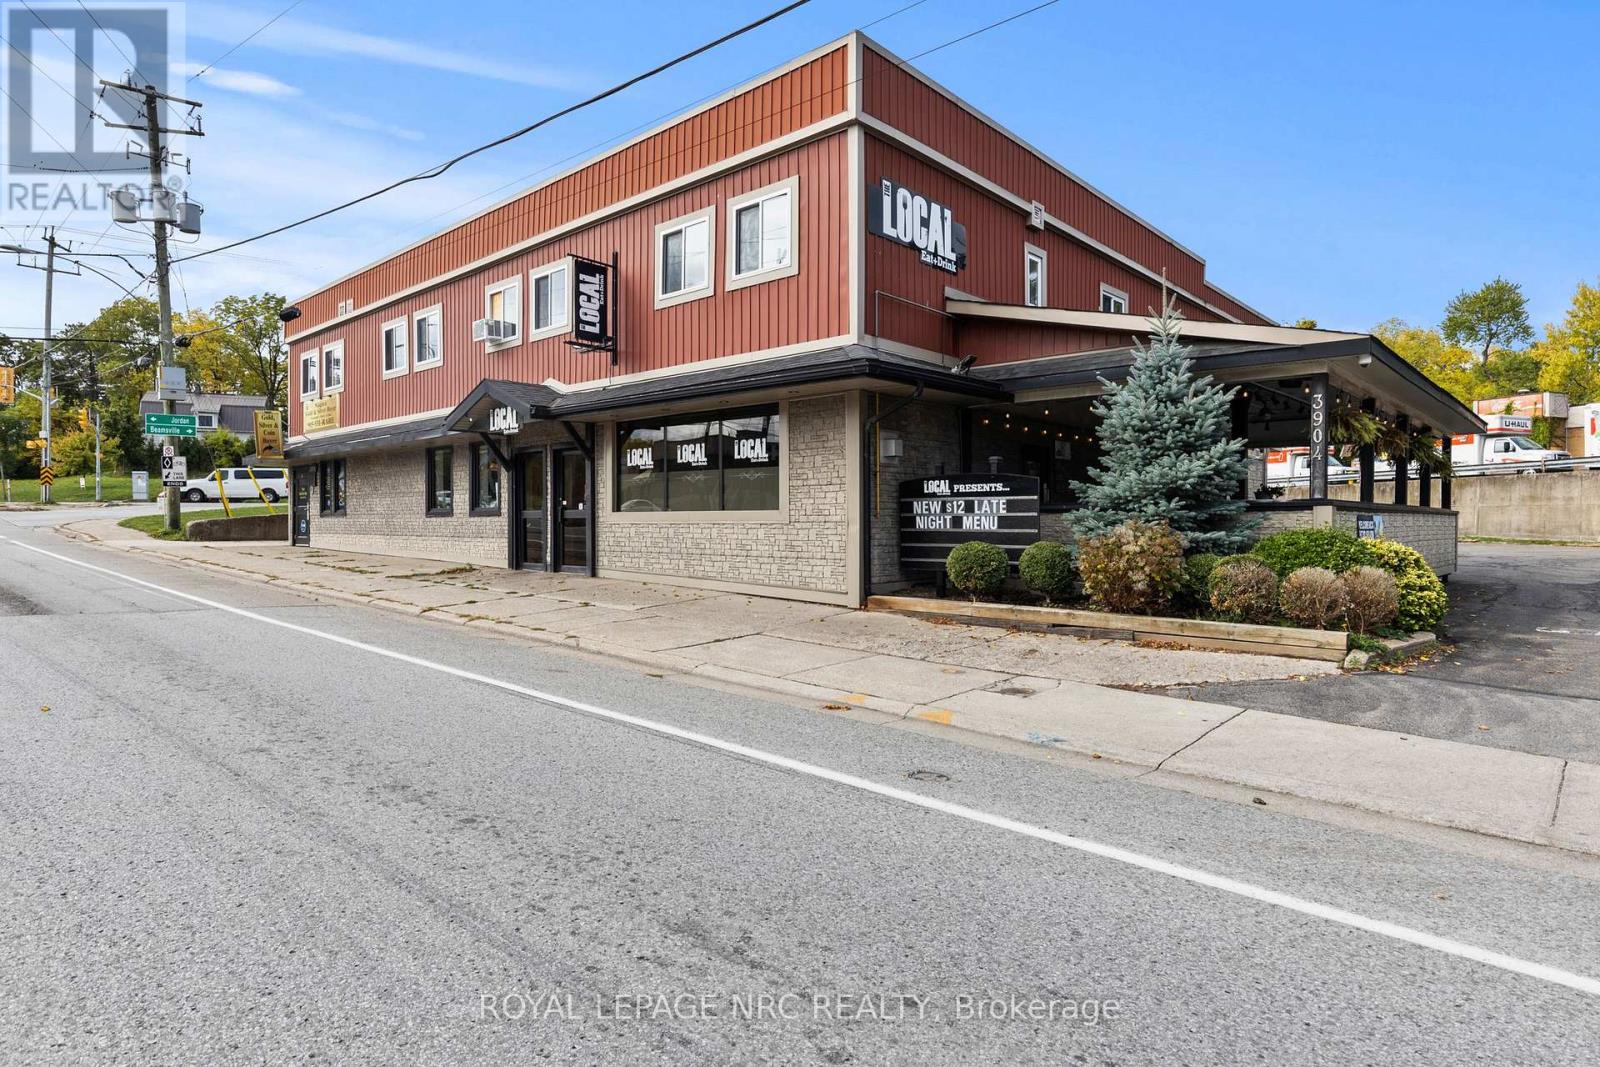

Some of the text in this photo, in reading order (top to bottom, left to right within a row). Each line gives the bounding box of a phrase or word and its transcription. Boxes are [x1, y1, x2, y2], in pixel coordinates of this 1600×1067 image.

[882, 179, 957, 262] LOCAL
[920, 249, 957, 273] Eat+Drink
[579, 273, 600, 334] LOCAL
[171, 416, 190, 424] Jordan
[489, 406, 519, 431] LOCAL
[1312, 393, 1323, 460] 3904
[150, 426, 180, 434] Beamsville
[626, 447, 654, 467] LOCAL
[677, 442, 707, 464] LOCAL
[734, 438, 769, 460] LOCAL
[923, 480, 1010, 494] LOCAL PRESENTS...
[913, 501, 942, 514] NEW
[974, 500, 1007, 514] LATE
[916, 515, 998, 530] NIGHT MENU
